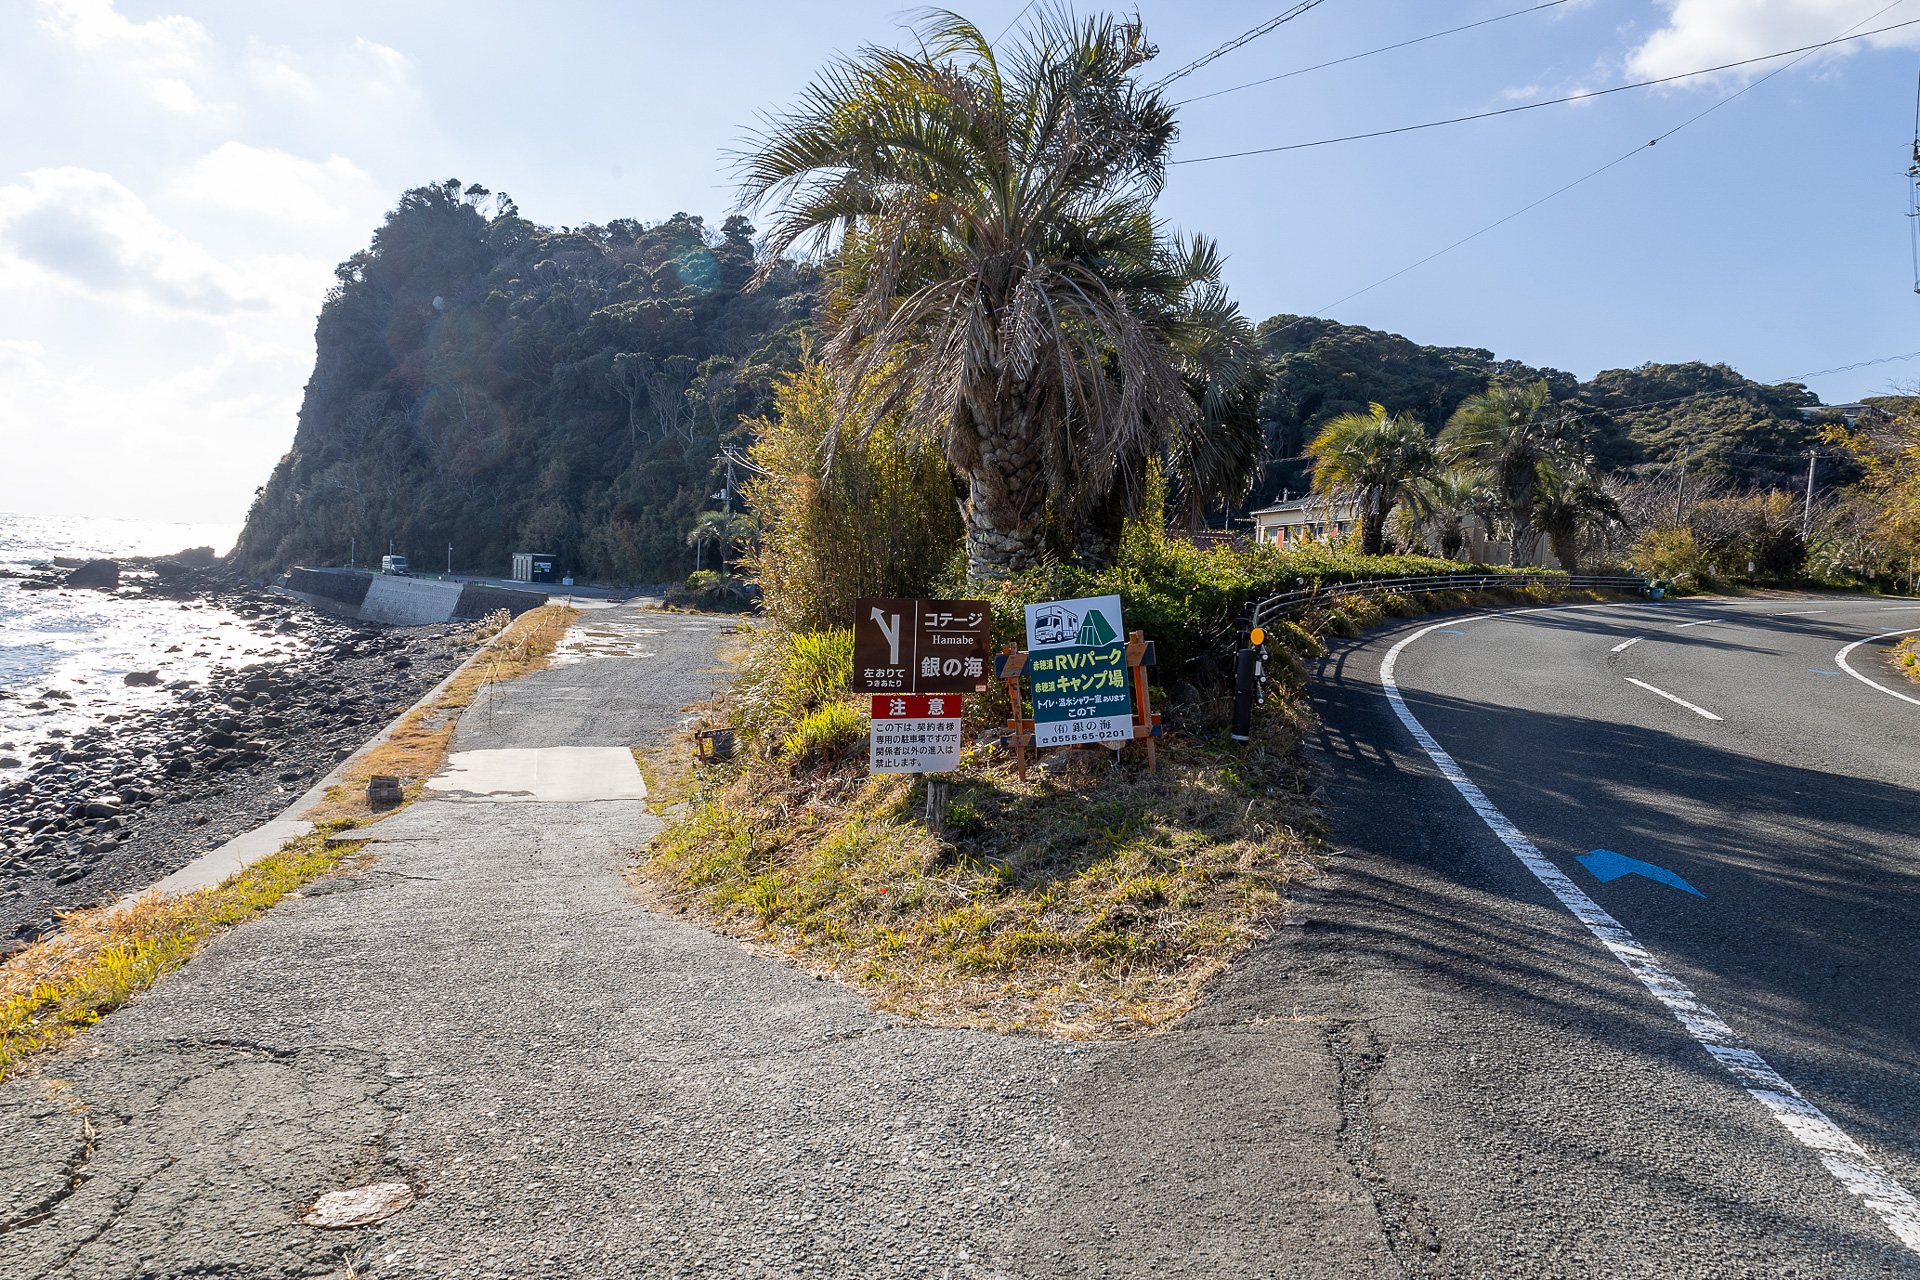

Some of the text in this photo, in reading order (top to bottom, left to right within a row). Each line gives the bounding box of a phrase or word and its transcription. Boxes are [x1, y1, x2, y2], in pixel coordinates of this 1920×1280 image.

[924, 612, 983, 627] コテージ
[932, 635, 974, 645] Hamabe
[921, 657, 983, 678] 銀の海
[864, 668, 905, 678] 左おりて
[866, 680, 902, 688] つきあたり
[889, 698, 945, 716] 注意
[1068, 707, 1096, 717] この下
[876, 722, 955, 732] この下は、契約者様
[876, 735, 957, 744] 専用の駐車場ですので
[1052, 730, 1124, 743] 0558-65-0201
[876, 746, 953, 756] 関係者以外の進入は
[875, 759, 922, 768] 禁止します。
